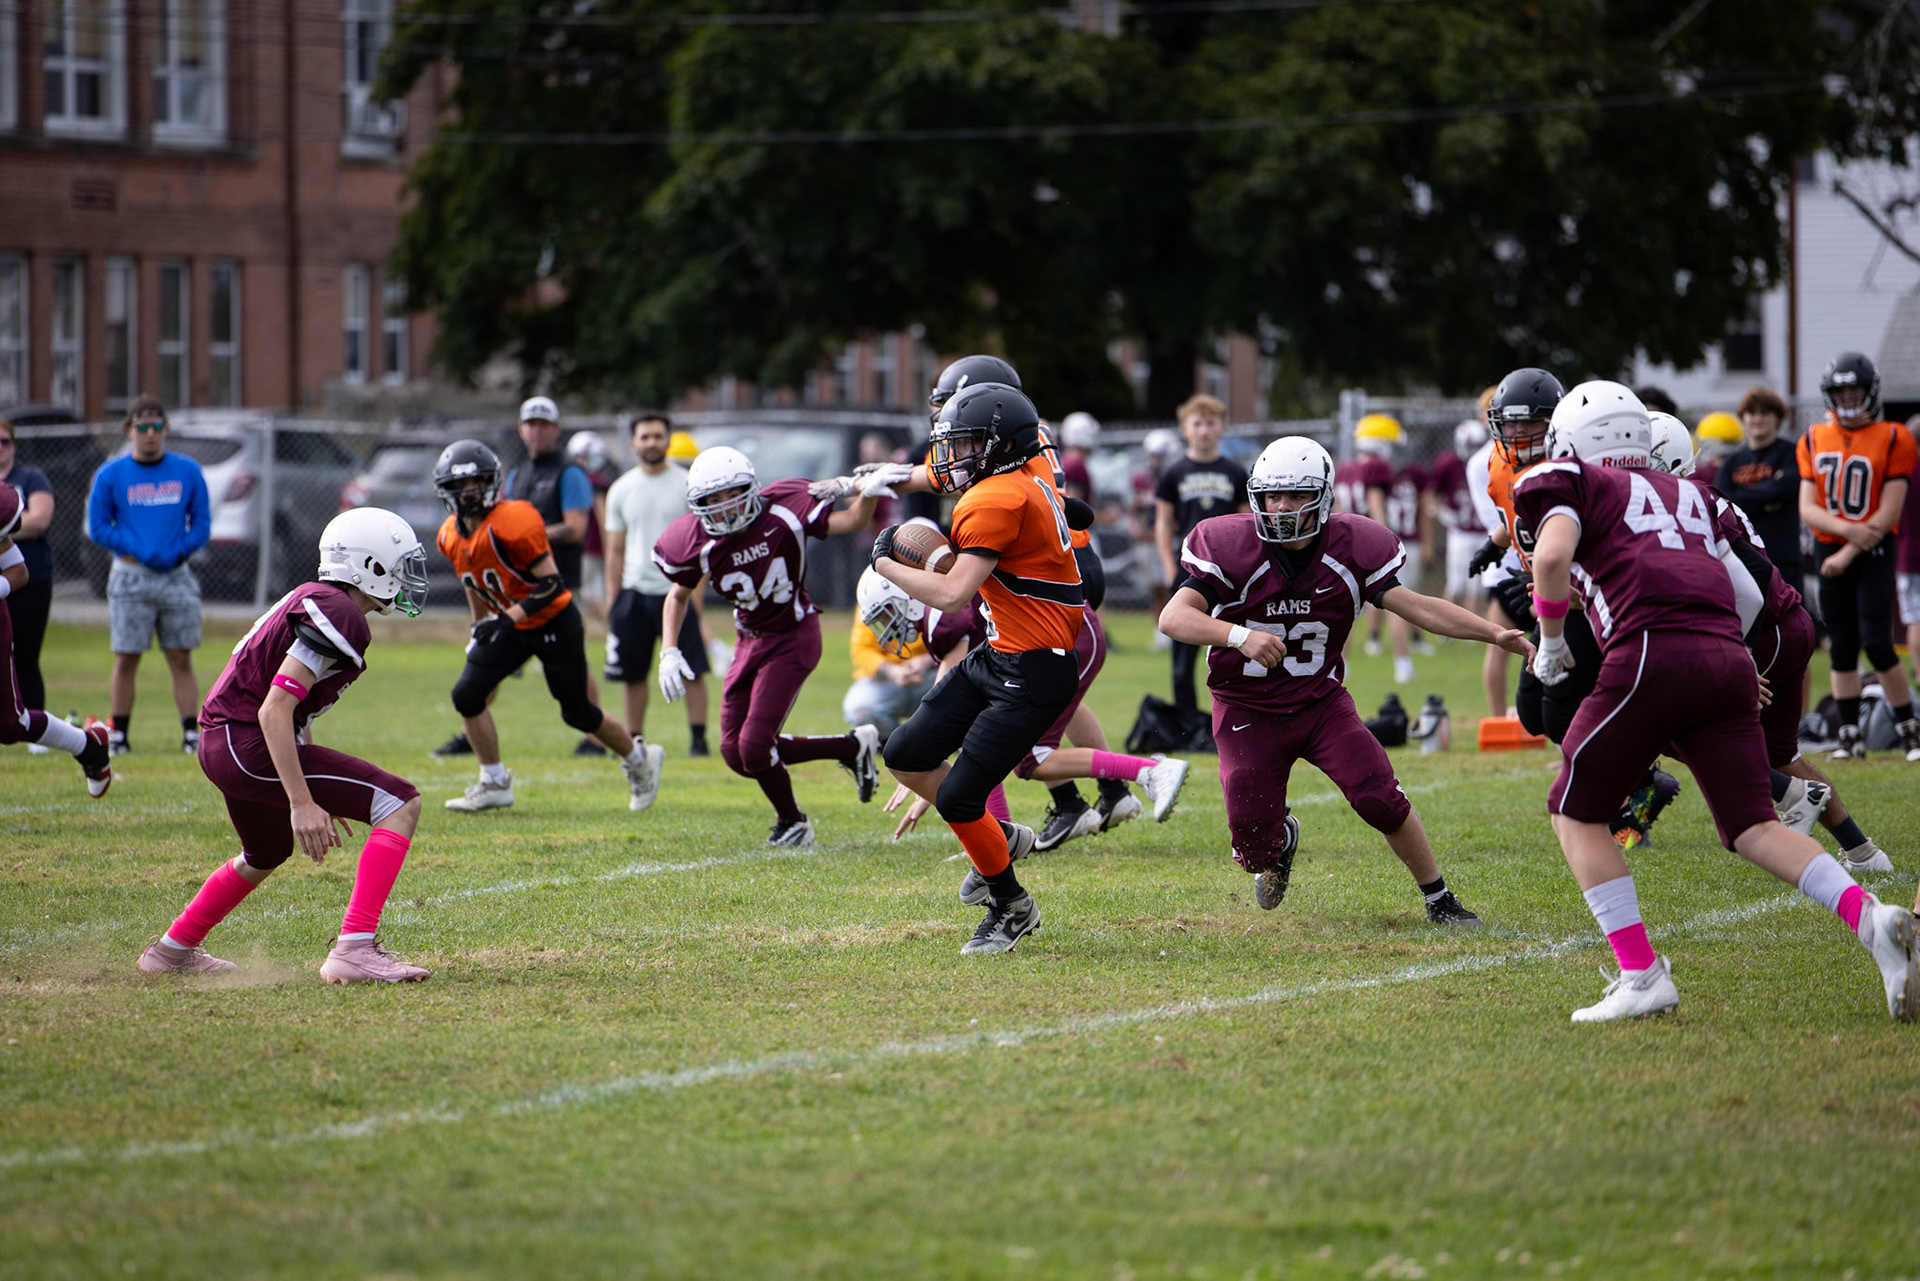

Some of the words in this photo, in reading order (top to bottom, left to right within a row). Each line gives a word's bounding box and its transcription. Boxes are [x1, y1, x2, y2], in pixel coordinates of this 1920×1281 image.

[1602, 455, 1647, 468] Riddell
[1815, 450, 1874, 520] 70
[1623, 472, 1719, 559] 44
[731, 541, 770, 567] RAMS
[720, 556, 793, 612] 34
[1266, 599, 1311, 617] RAMS
